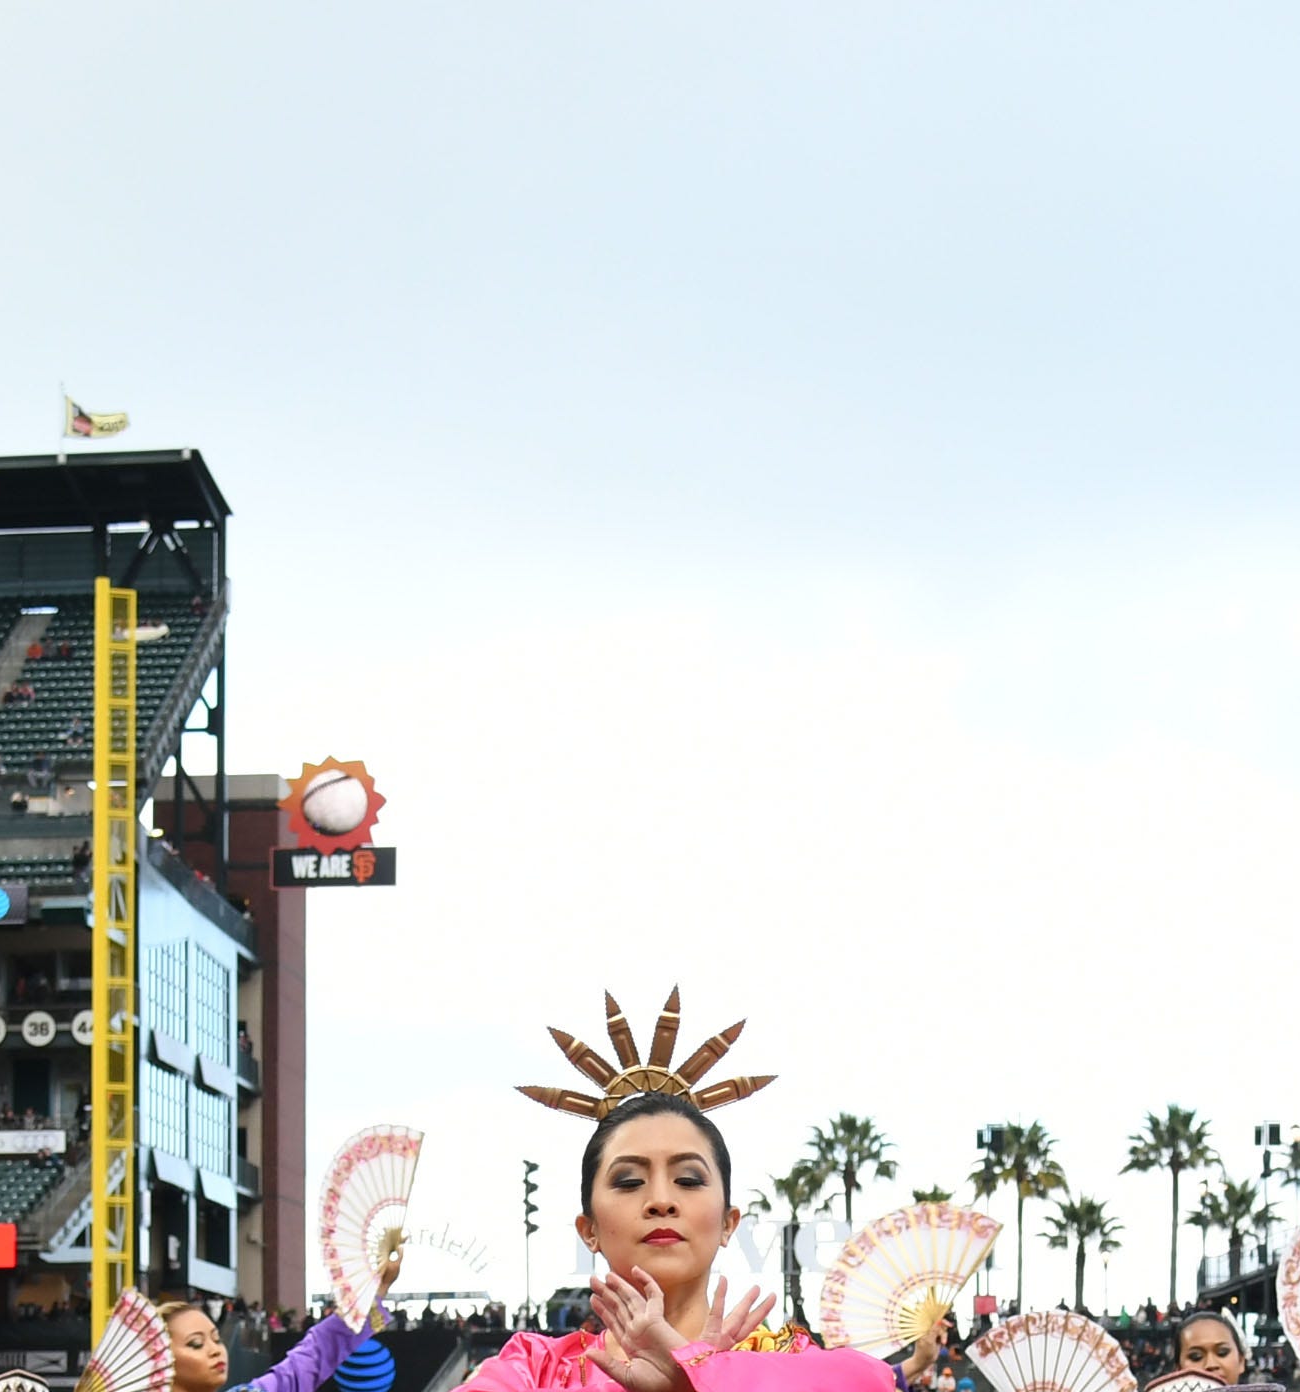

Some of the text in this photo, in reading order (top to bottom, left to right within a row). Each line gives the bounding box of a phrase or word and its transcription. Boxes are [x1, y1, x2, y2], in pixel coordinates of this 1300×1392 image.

[291, 855, 318, 879] WE
[319, 854, 351, 878] ARE
[78, 1020, 93, 1034] 4
